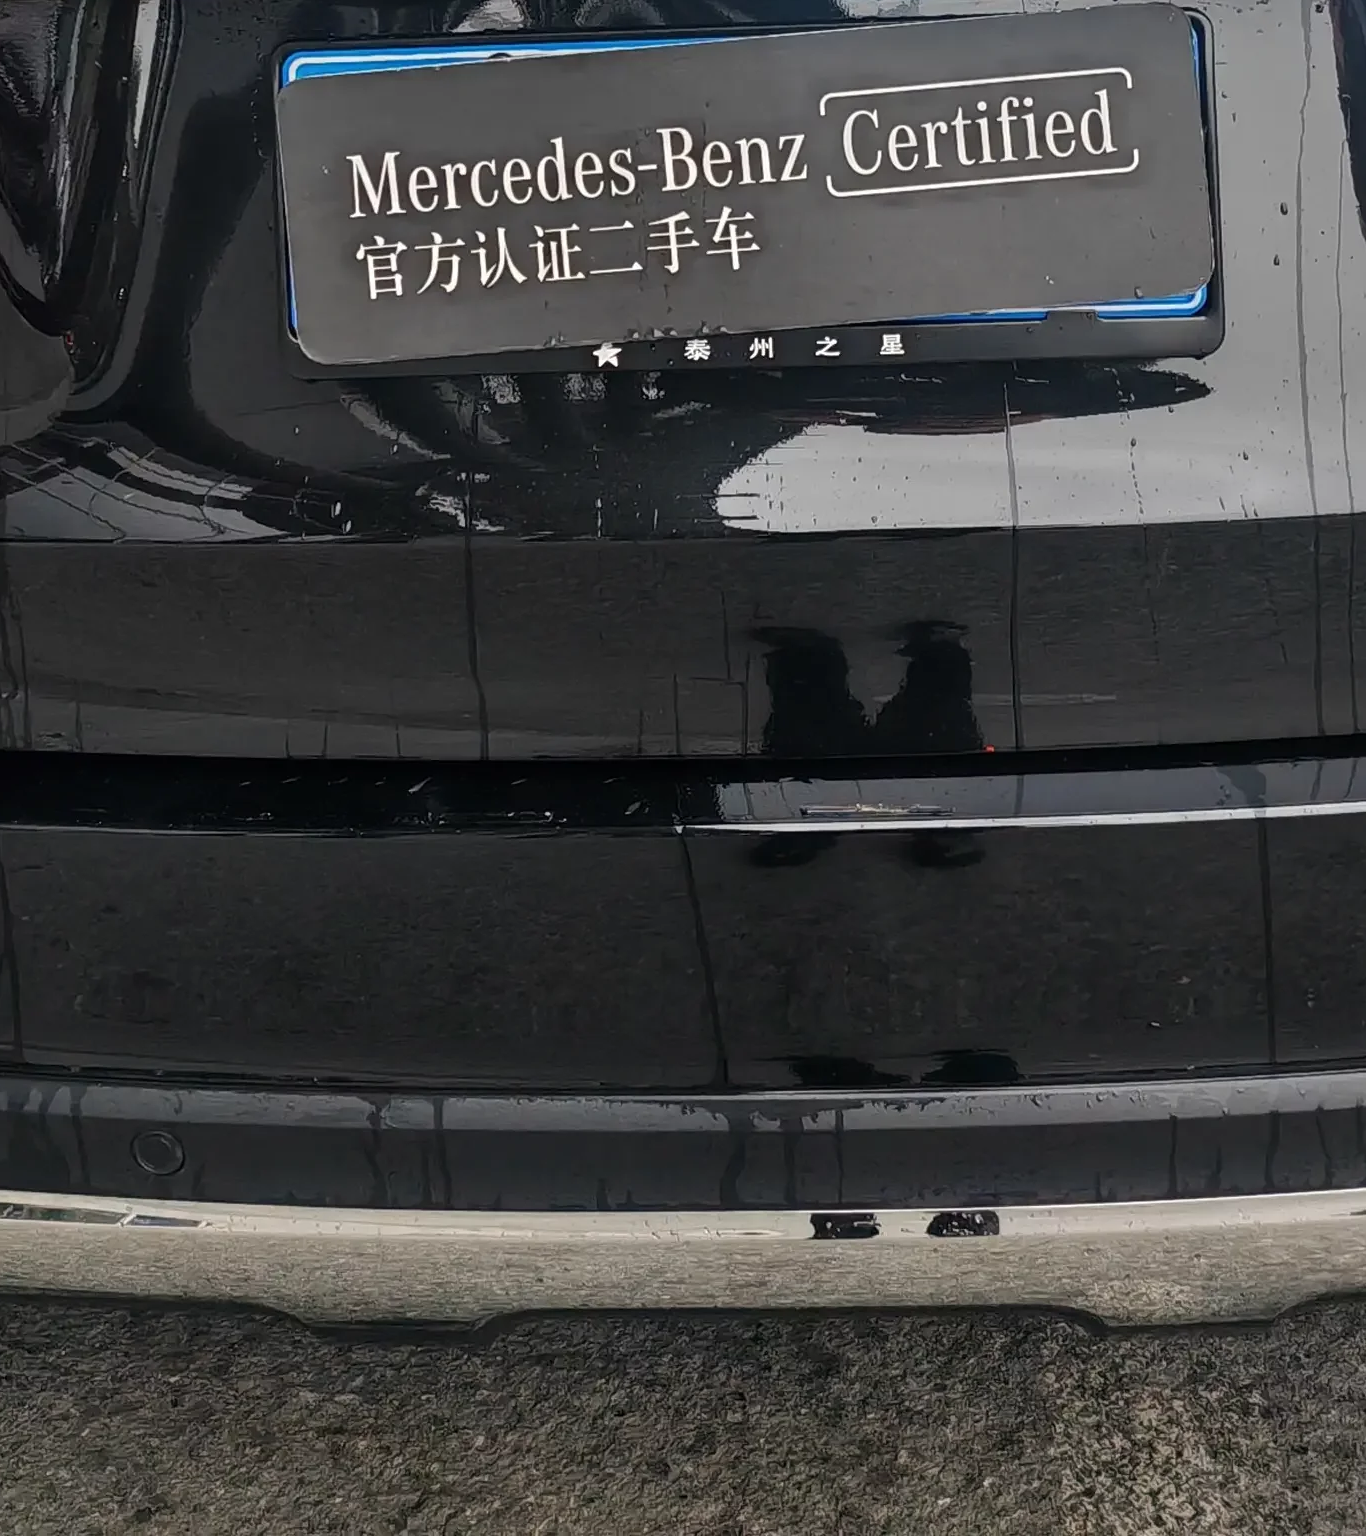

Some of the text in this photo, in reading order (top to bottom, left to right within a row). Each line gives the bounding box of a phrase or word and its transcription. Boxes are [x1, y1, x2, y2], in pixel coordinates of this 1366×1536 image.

[346, 90, 1118, 219] Mercedes-Benz Certified
[355, 205, 762, 300] 官方认证二手车
[684, 334, 905, 361] 泰州之星
